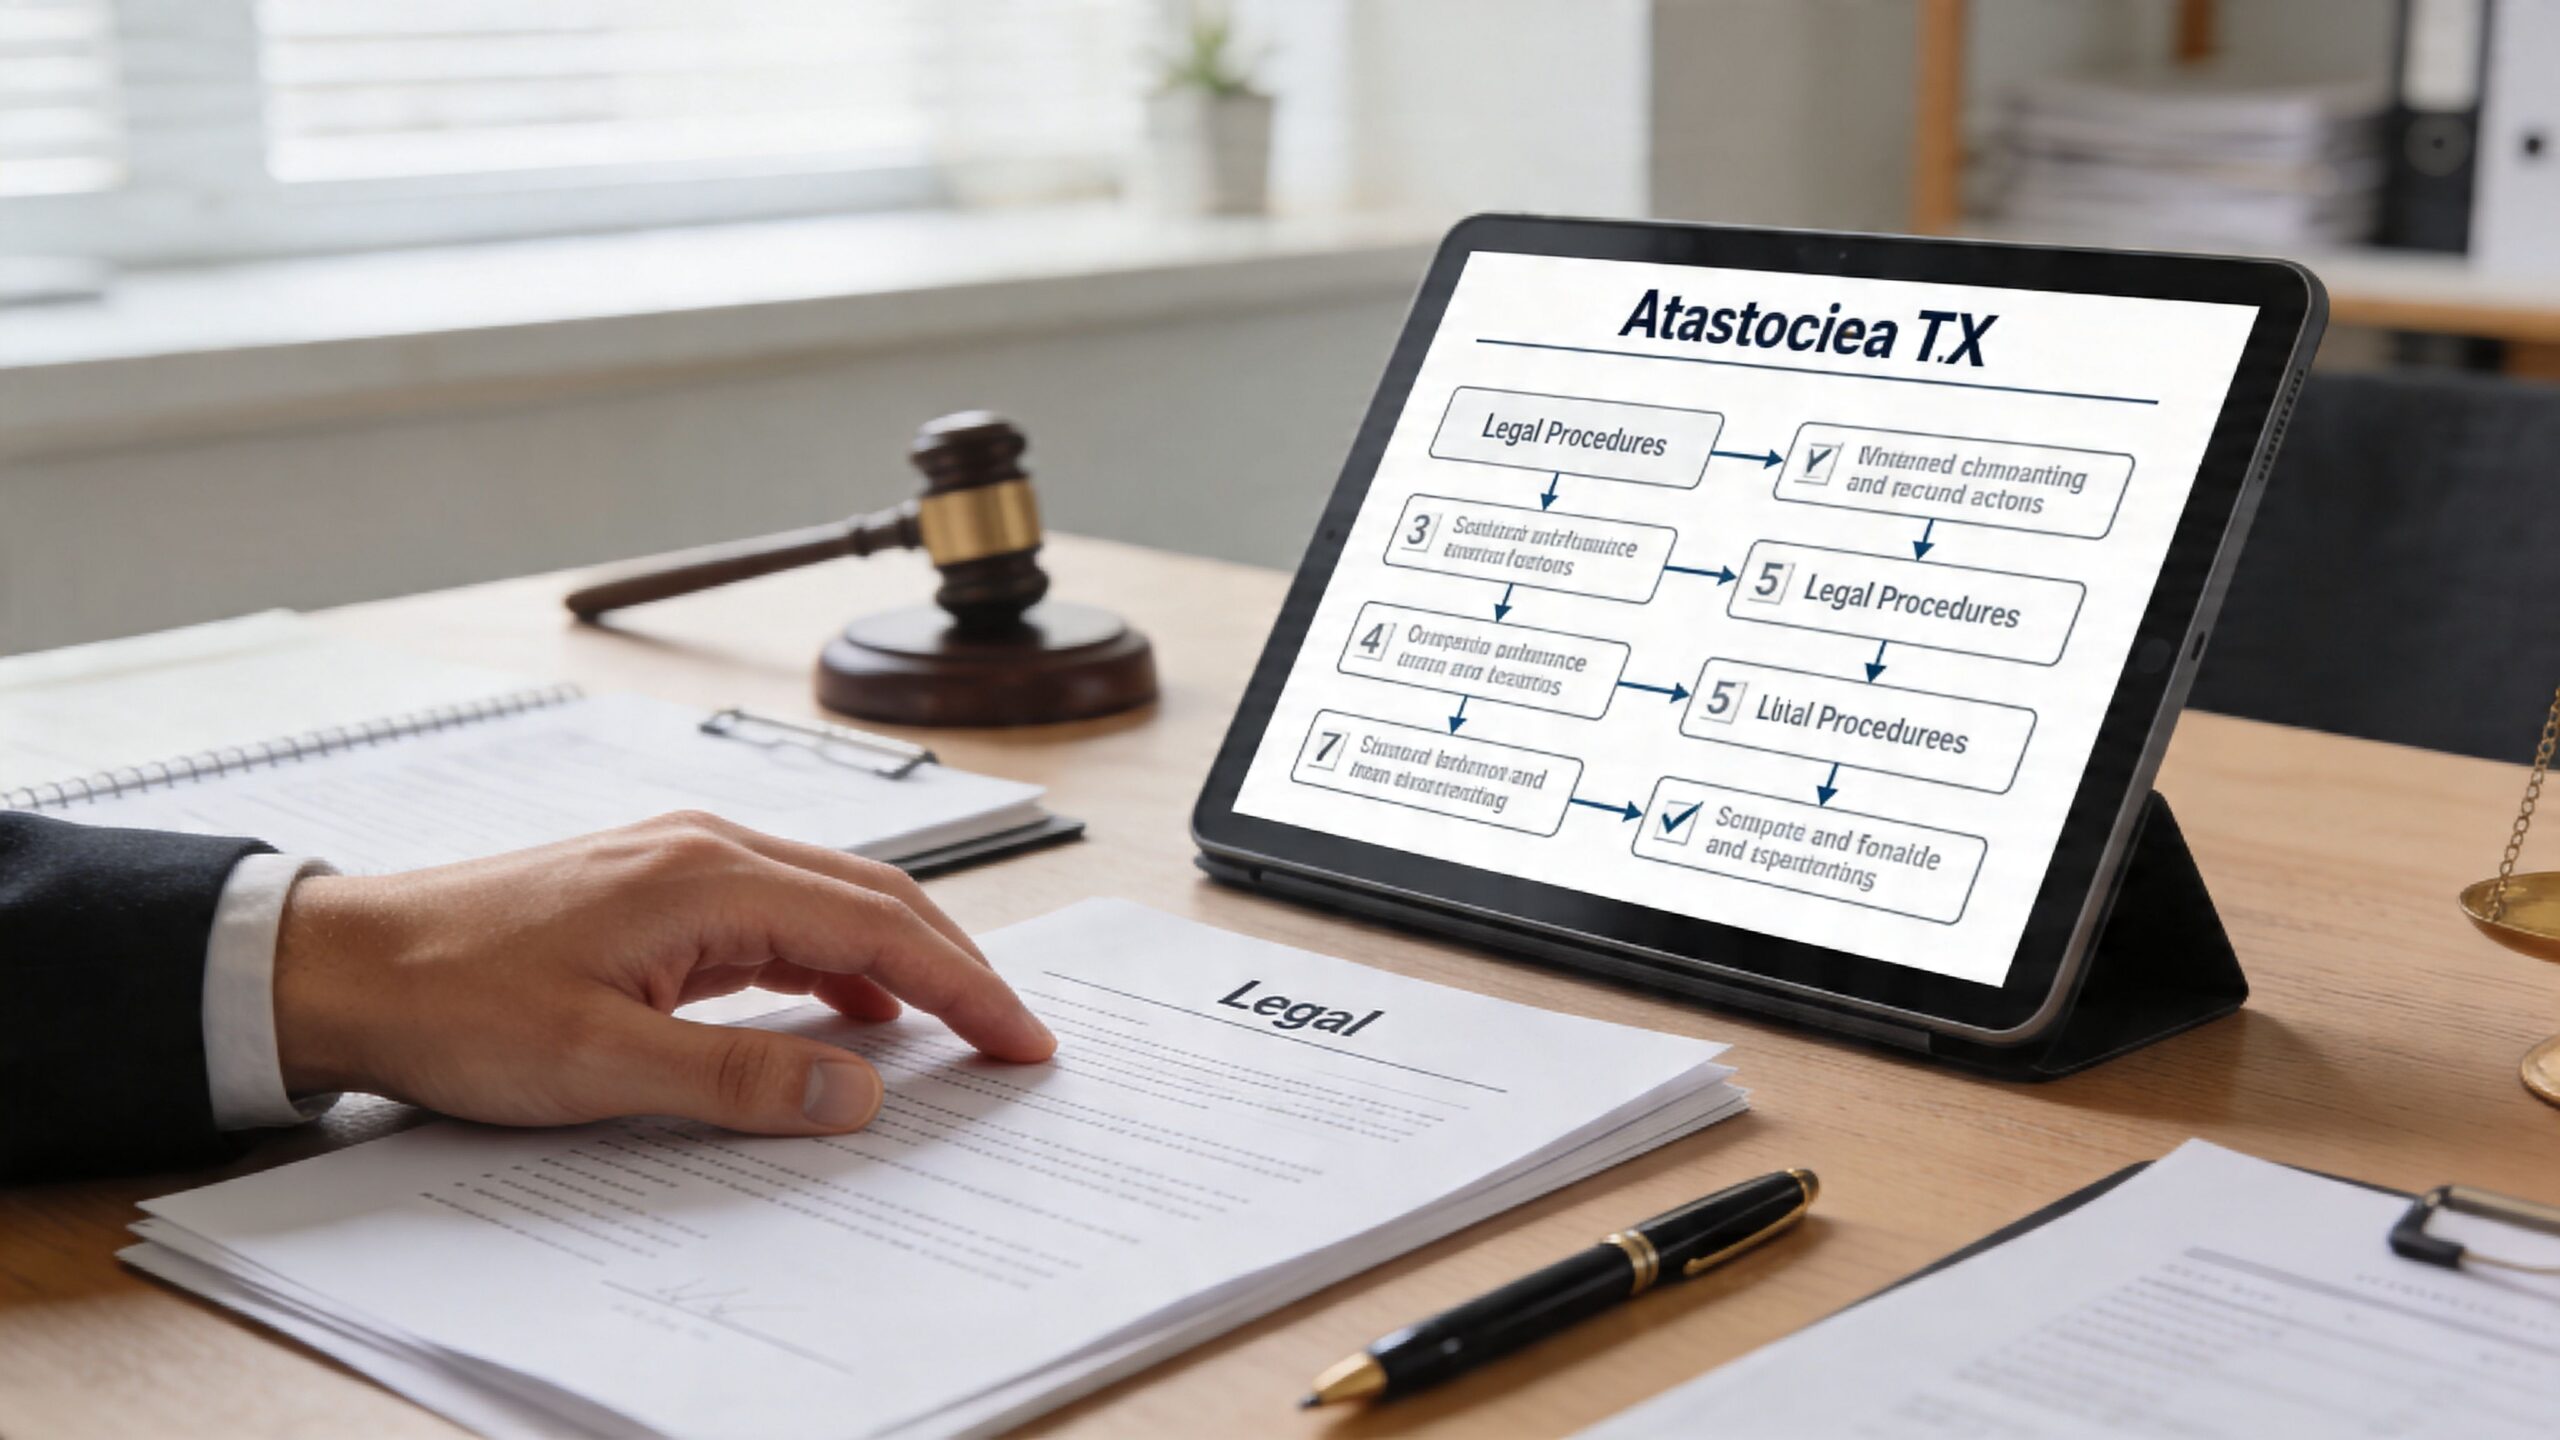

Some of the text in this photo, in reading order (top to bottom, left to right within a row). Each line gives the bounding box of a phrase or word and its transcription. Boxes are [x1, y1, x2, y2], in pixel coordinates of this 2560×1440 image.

[1618, 288, 1899, 359] Atastociea
[1481, 413, 1668, 457] Legal Procedures
[1846, 474, 1889, 495] and
[1406, 514, 1431, 545] 3
[1753, 562, 1785, 596] 5
[1803, 574, 2021, 628] Legal Procedures
[1360, 623, 1385, 654] 4
[1707, 680, 1737, 714] 5
[1816, 705, 1969, 754] Procedurees
[1316, 732, 1342, 762] 7
[1706, 837, 1748, 860] and
[1811, 829, 1854, 851] and
[1217, 980, 1387, 1038] Legal
